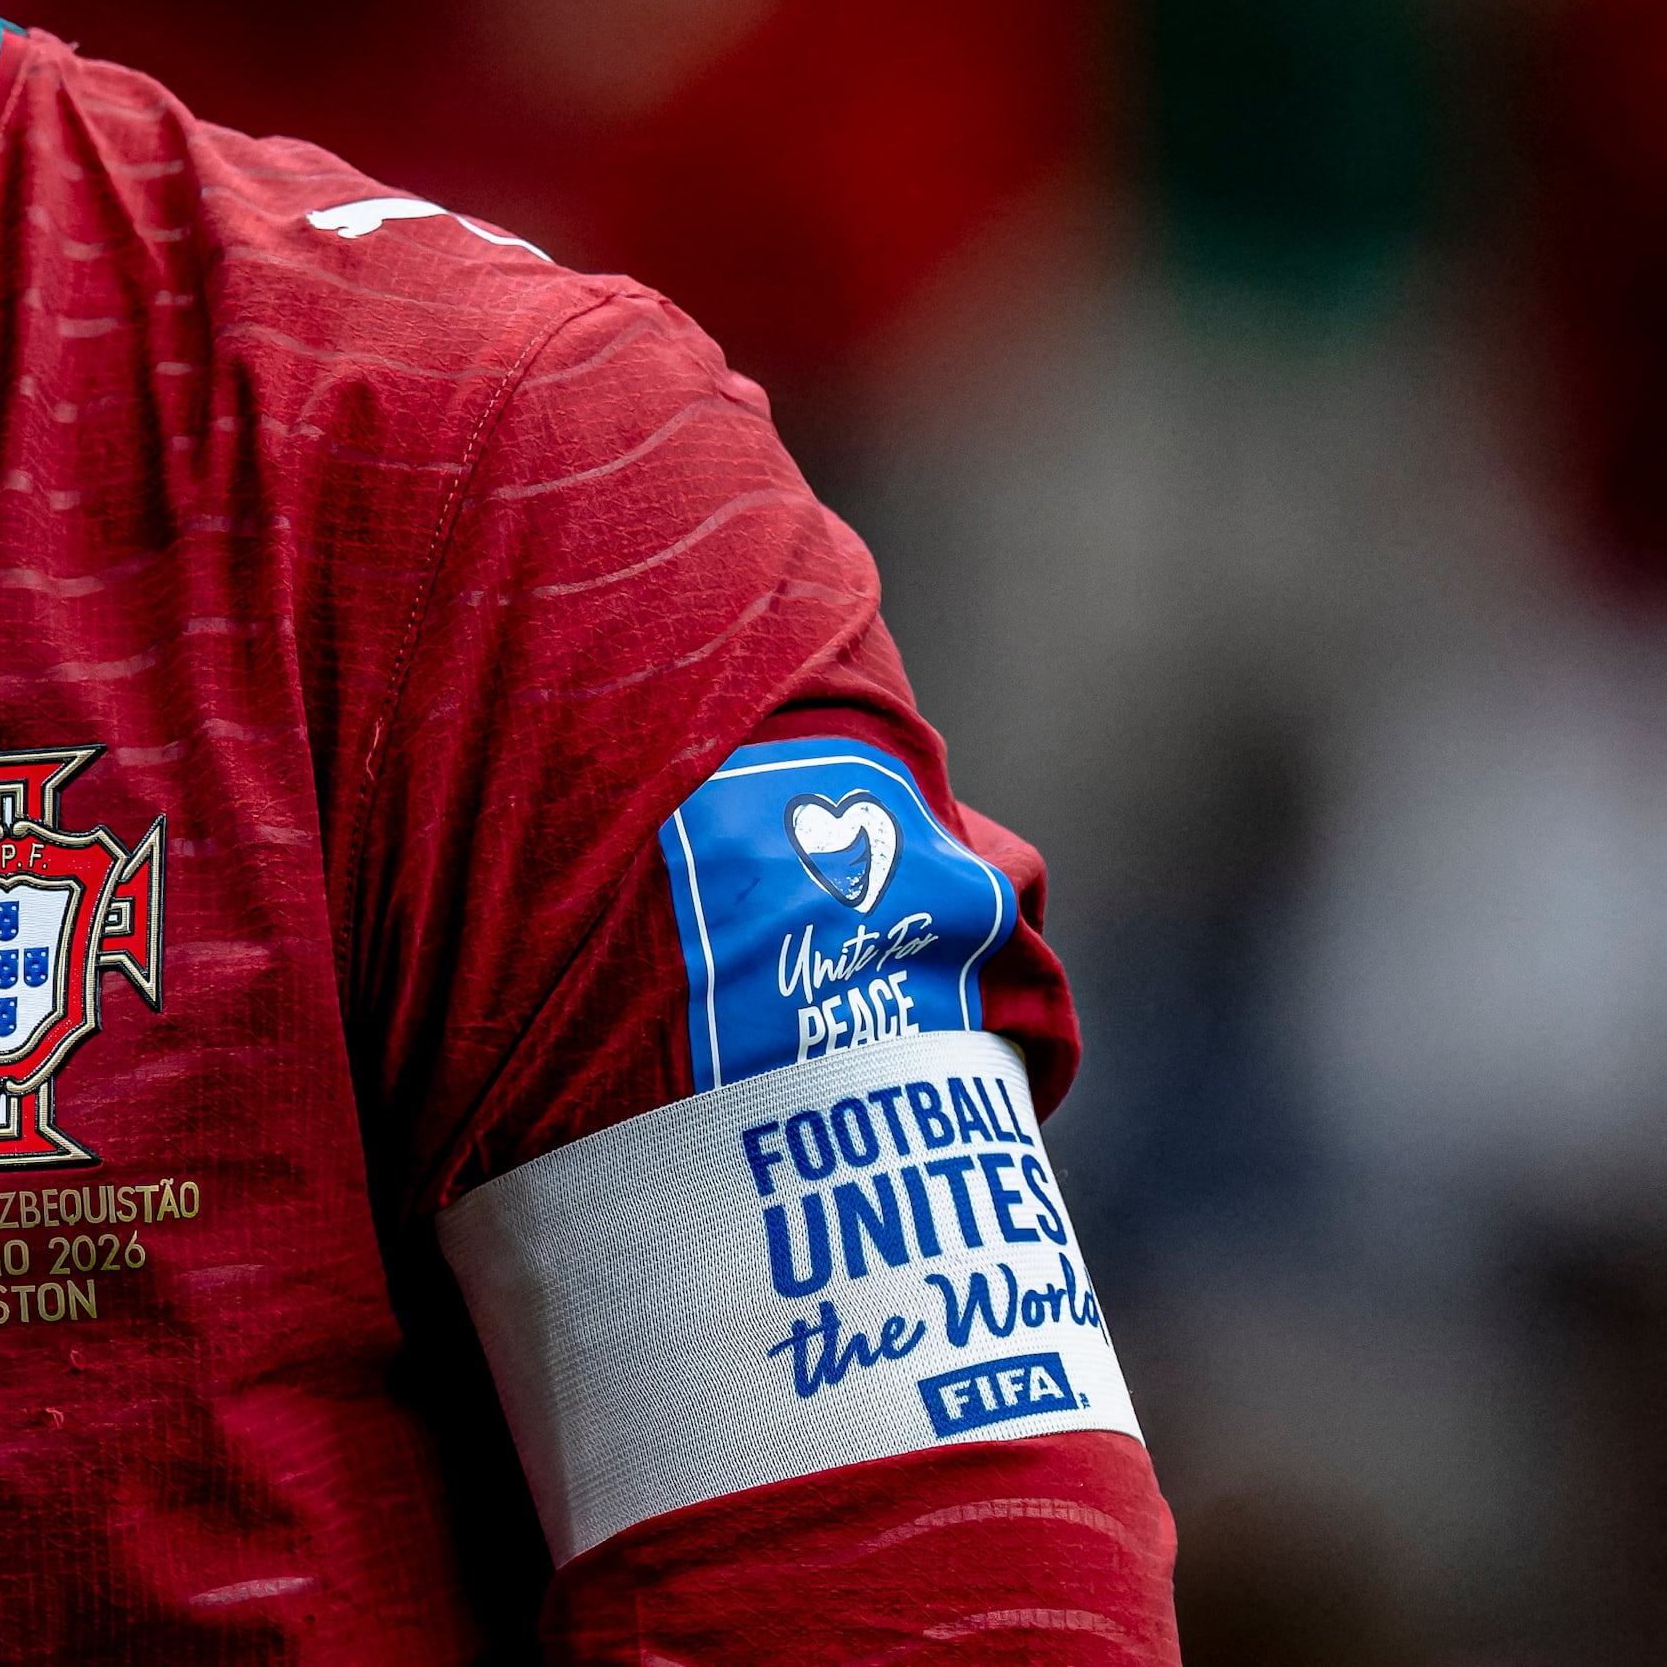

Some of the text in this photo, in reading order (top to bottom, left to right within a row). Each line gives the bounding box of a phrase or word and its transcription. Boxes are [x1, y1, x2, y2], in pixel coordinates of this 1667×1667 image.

[778, 912, 939, 1004] Unite For
[797, 970, 920, 1063] PEACE
[742, 1076, 1034, 1197] FOOTBALL
[49, 1230, 147, 1276] 2026
[763, 1152, 1067, 1298] UNITES
[767, 1252, 1109, 1399] the World
[938, 1365, 1063, 1420] FIFA
